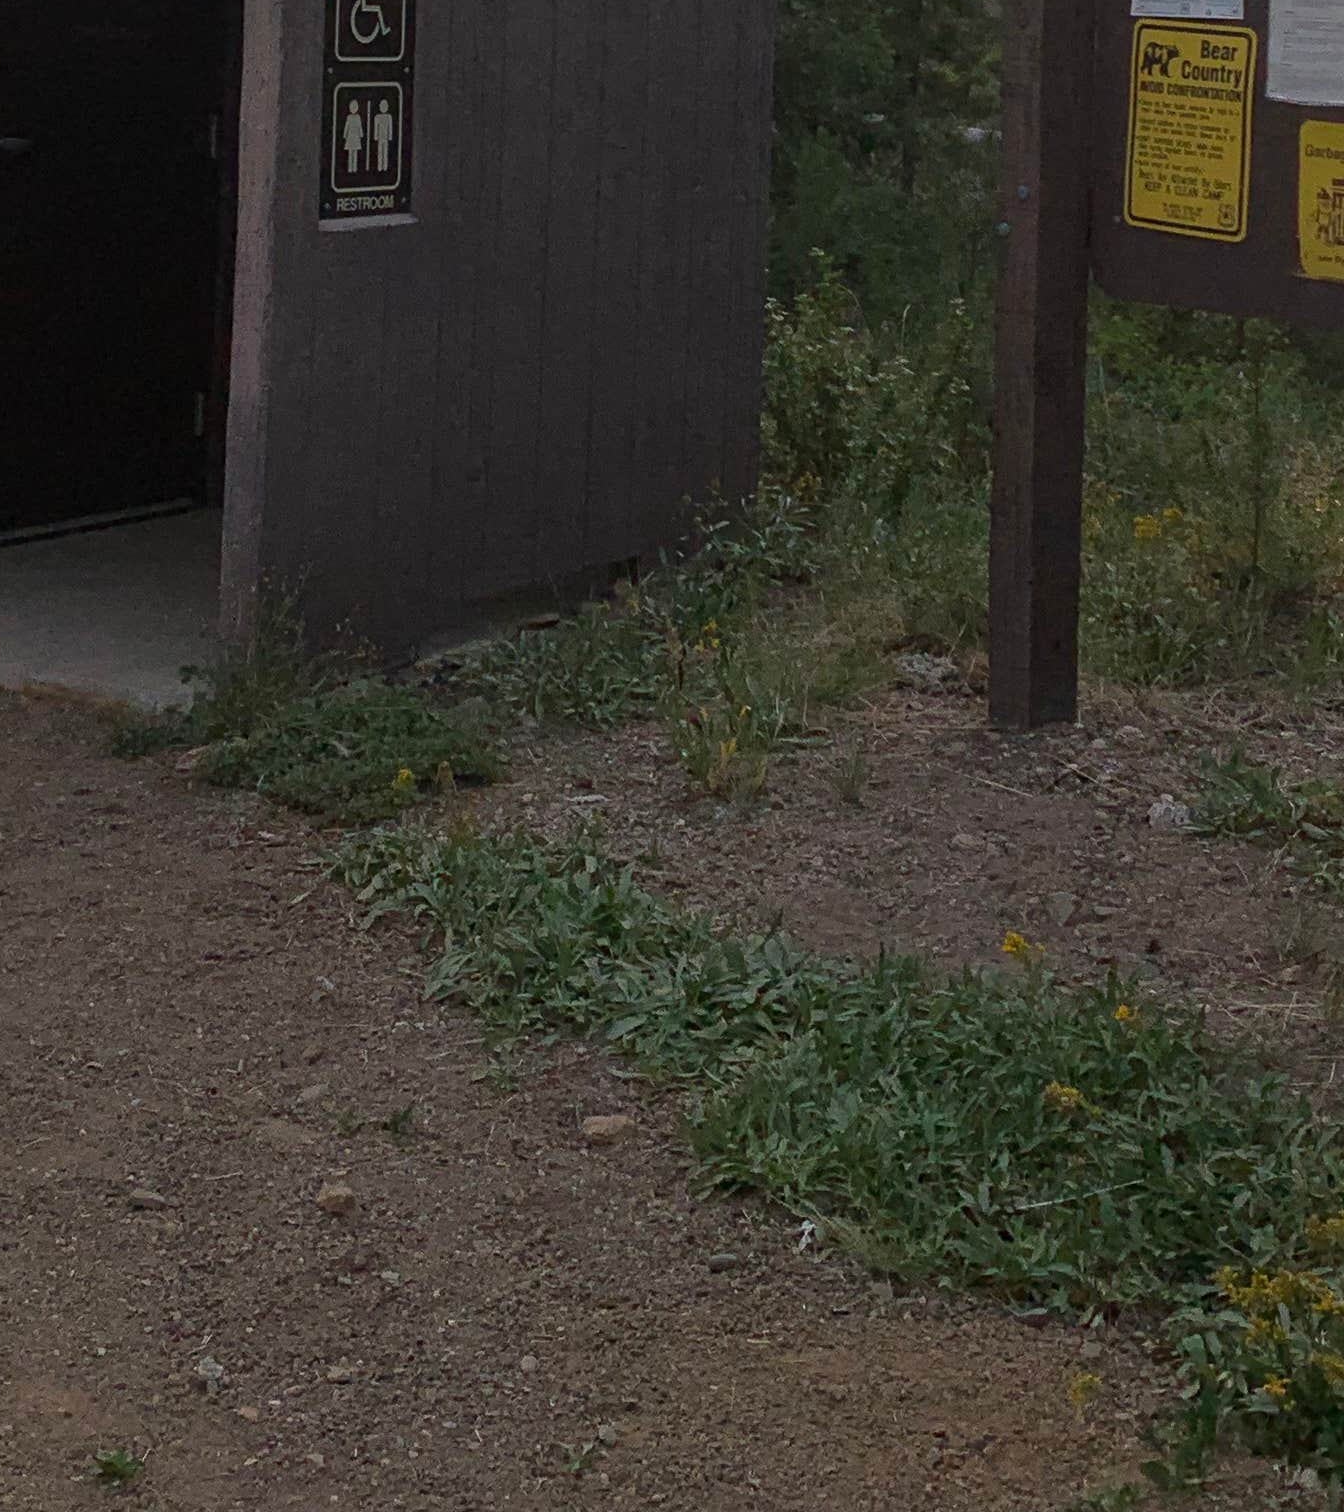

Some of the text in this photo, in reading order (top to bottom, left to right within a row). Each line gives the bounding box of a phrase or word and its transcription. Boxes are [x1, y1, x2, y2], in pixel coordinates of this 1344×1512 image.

[1200, 39, 1238, 62] Bear
[1181, 59, 1243, 89] Country
[336, 194, 395, 212] RESTROOM
